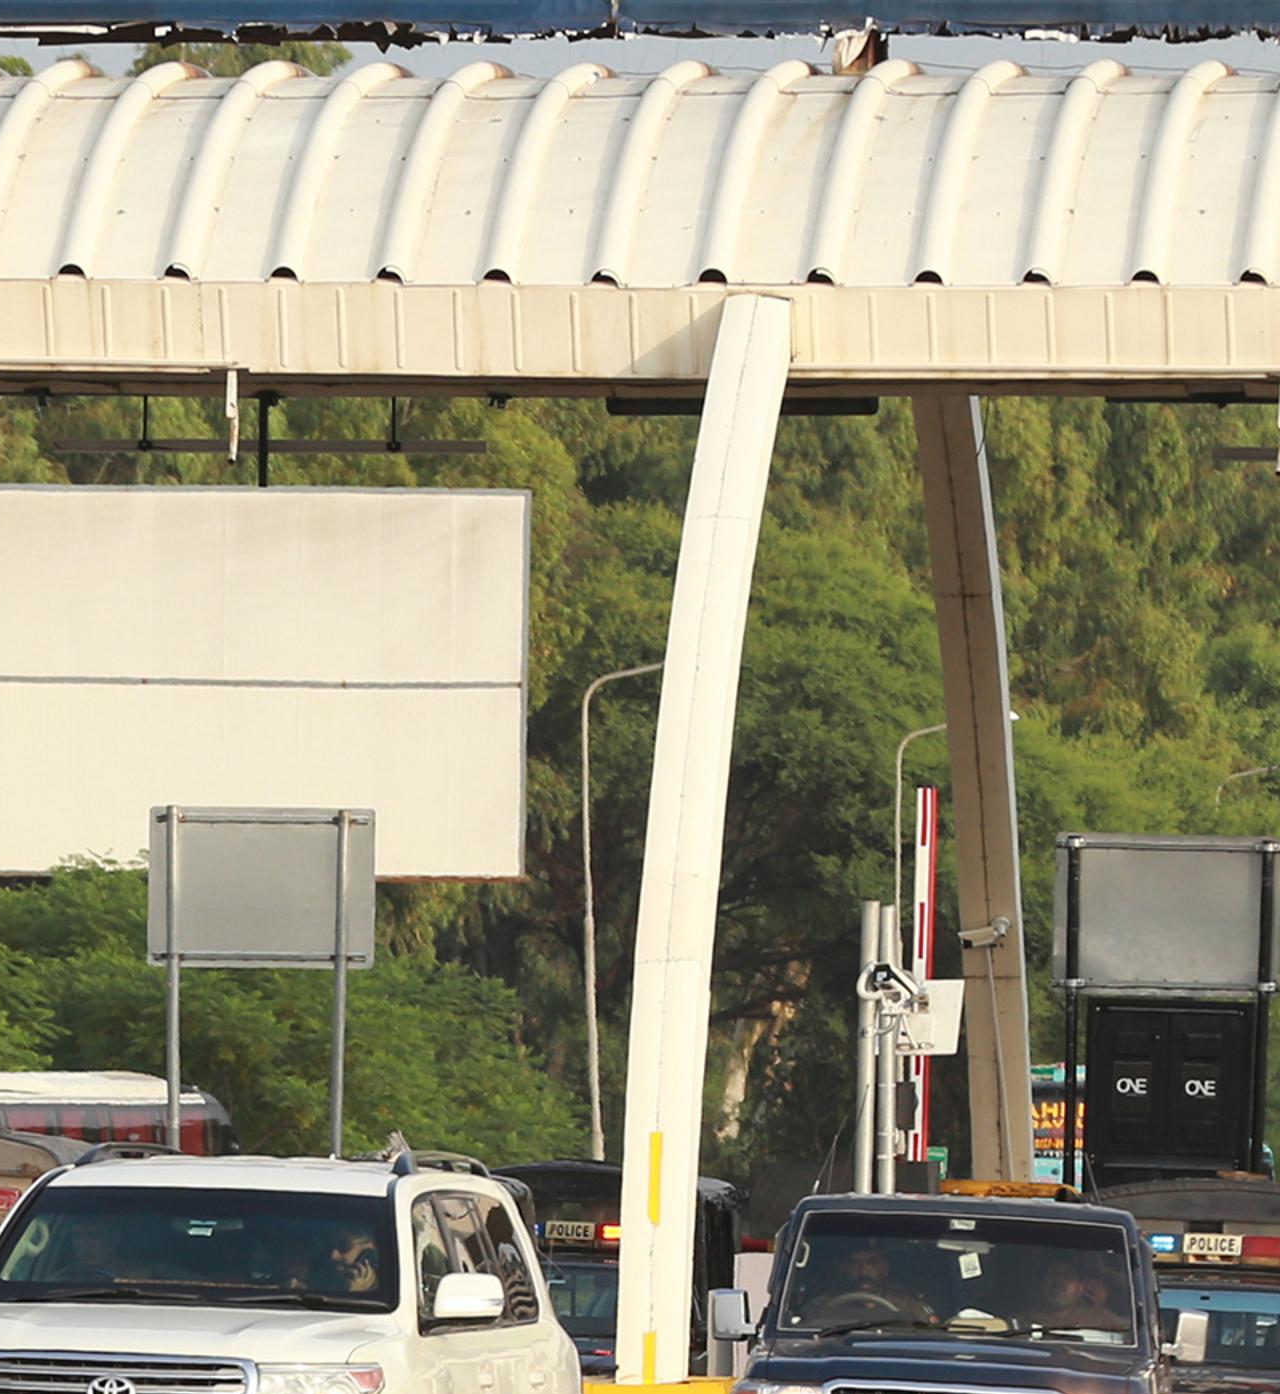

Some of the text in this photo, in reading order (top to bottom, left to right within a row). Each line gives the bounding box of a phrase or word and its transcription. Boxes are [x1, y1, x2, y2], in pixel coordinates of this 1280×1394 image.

[1116, 1078, 1148, 1095] ONE
[1184, 1079, 1217, 1097] ONE
[548, 1223, 591, 1238] POLICE
[1189, 1236, 1237, 1252] POLICE
